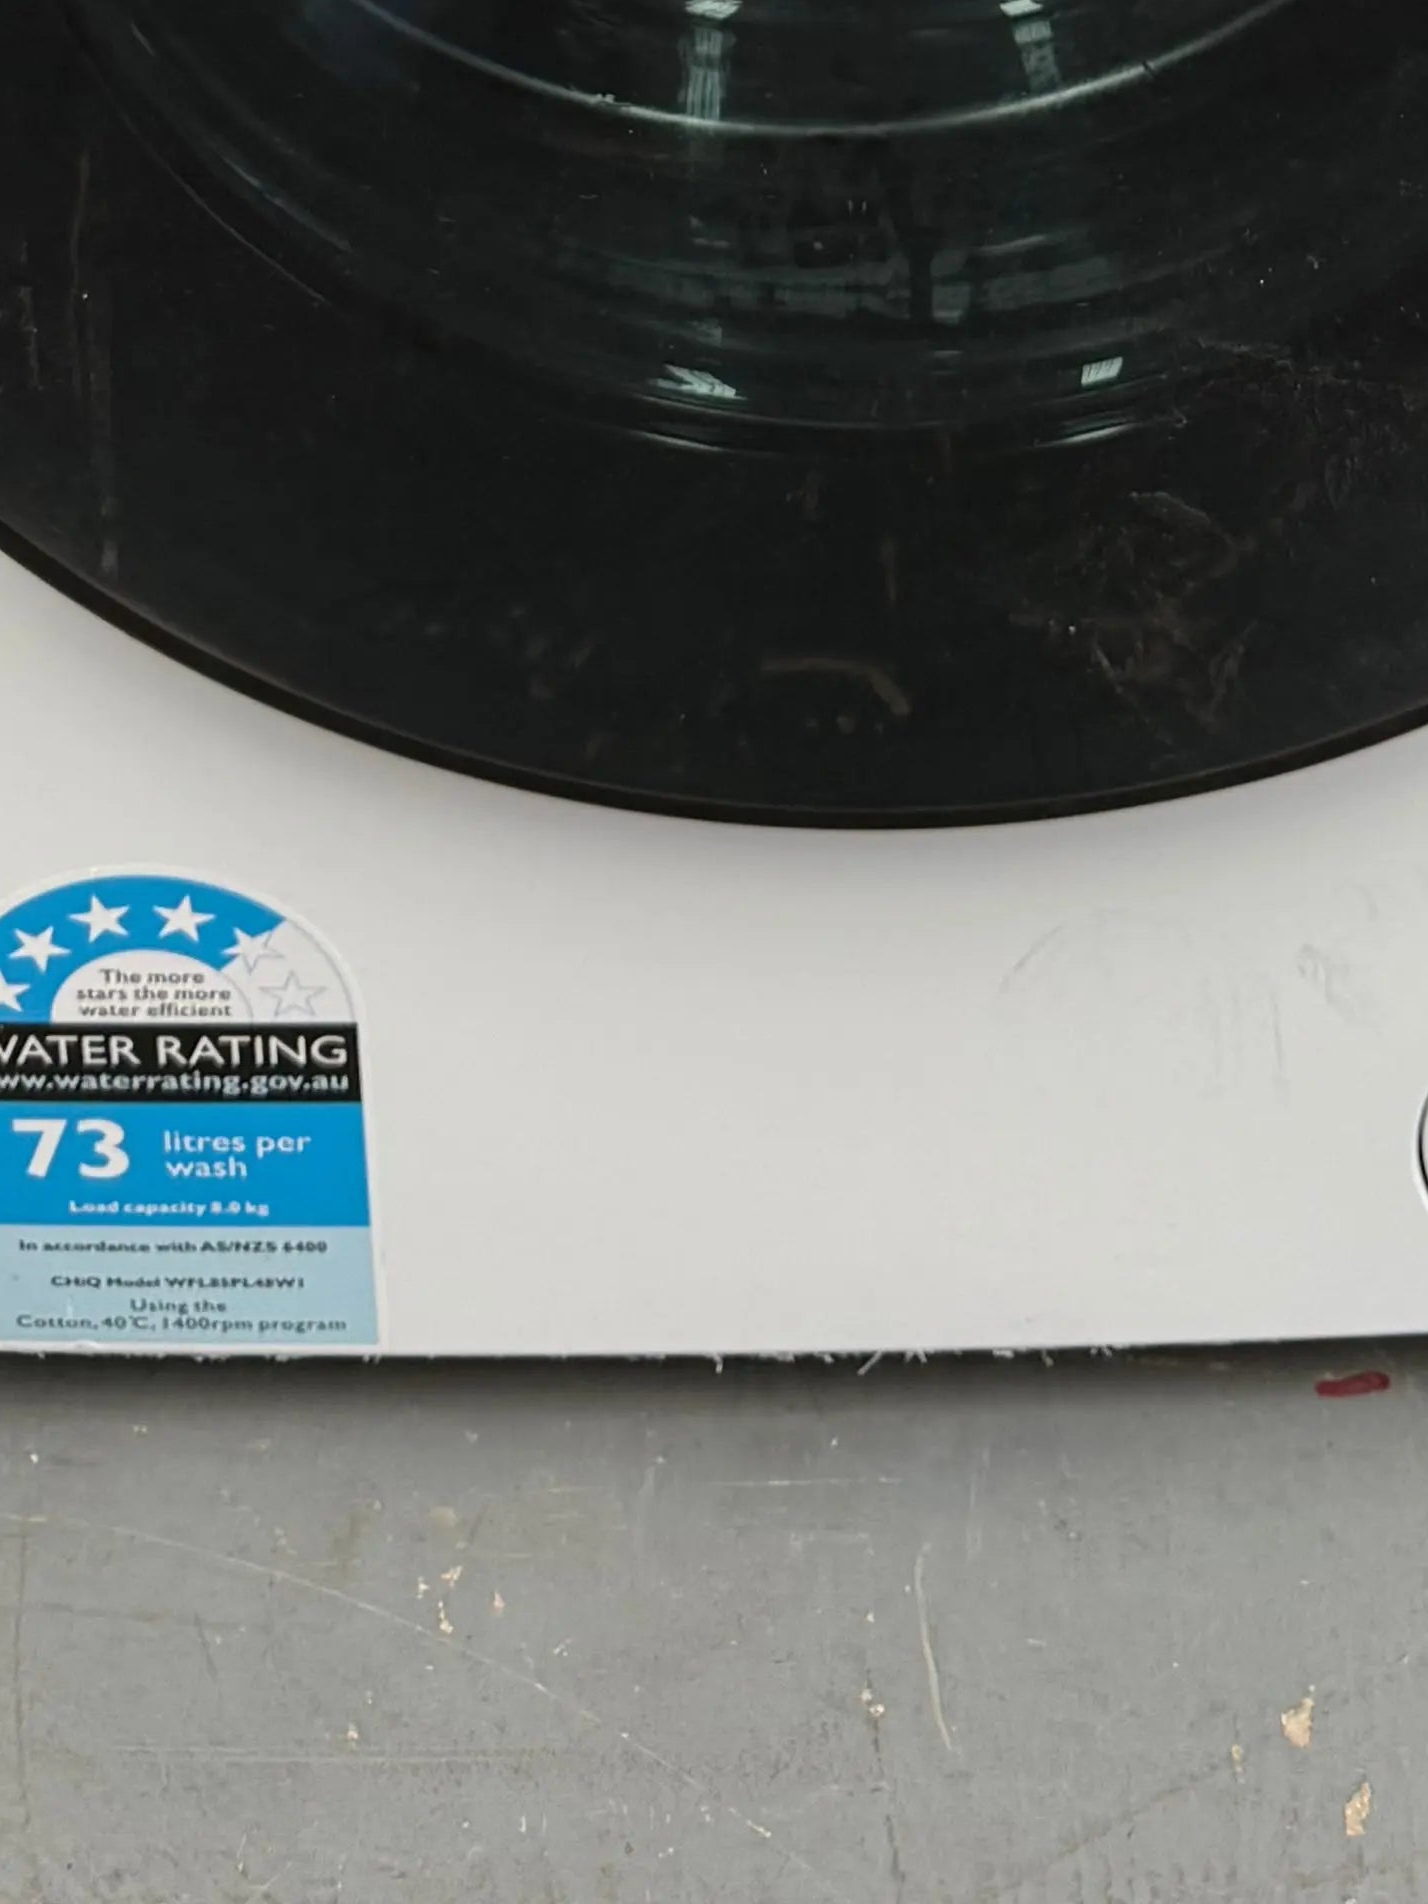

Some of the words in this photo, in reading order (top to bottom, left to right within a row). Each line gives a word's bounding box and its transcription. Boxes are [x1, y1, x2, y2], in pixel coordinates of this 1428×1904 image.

[99, 968, 142, 984] The
[146, 971, 205, 985] more
[76, 986, 128, 1001] stars
[133, 985, 169, 1001] the
[174, 988, 232, 1001] more
[78, 1004, 140, 1017] water
[146, 1002, 233, 1018] efficient
[156, 1034, 349, 1068] RATING
[12, 1118, 131, 1180] 73
[162, 1129, 247, 1154] litres
[255, 1133, 312, 1160] per
[164, 1155, 249, 1180] wash
[68, 1200, 119, 1214] Load
[123, 1200, 207, 1217] capacity
[18, 1239, 38, 1252] In
[157, 1239, 198, 1253] with
[129, 1298, 189, 1316] Using
[193, 1299, 228, 1314] the
[258, 1317, 348, 1335] program
